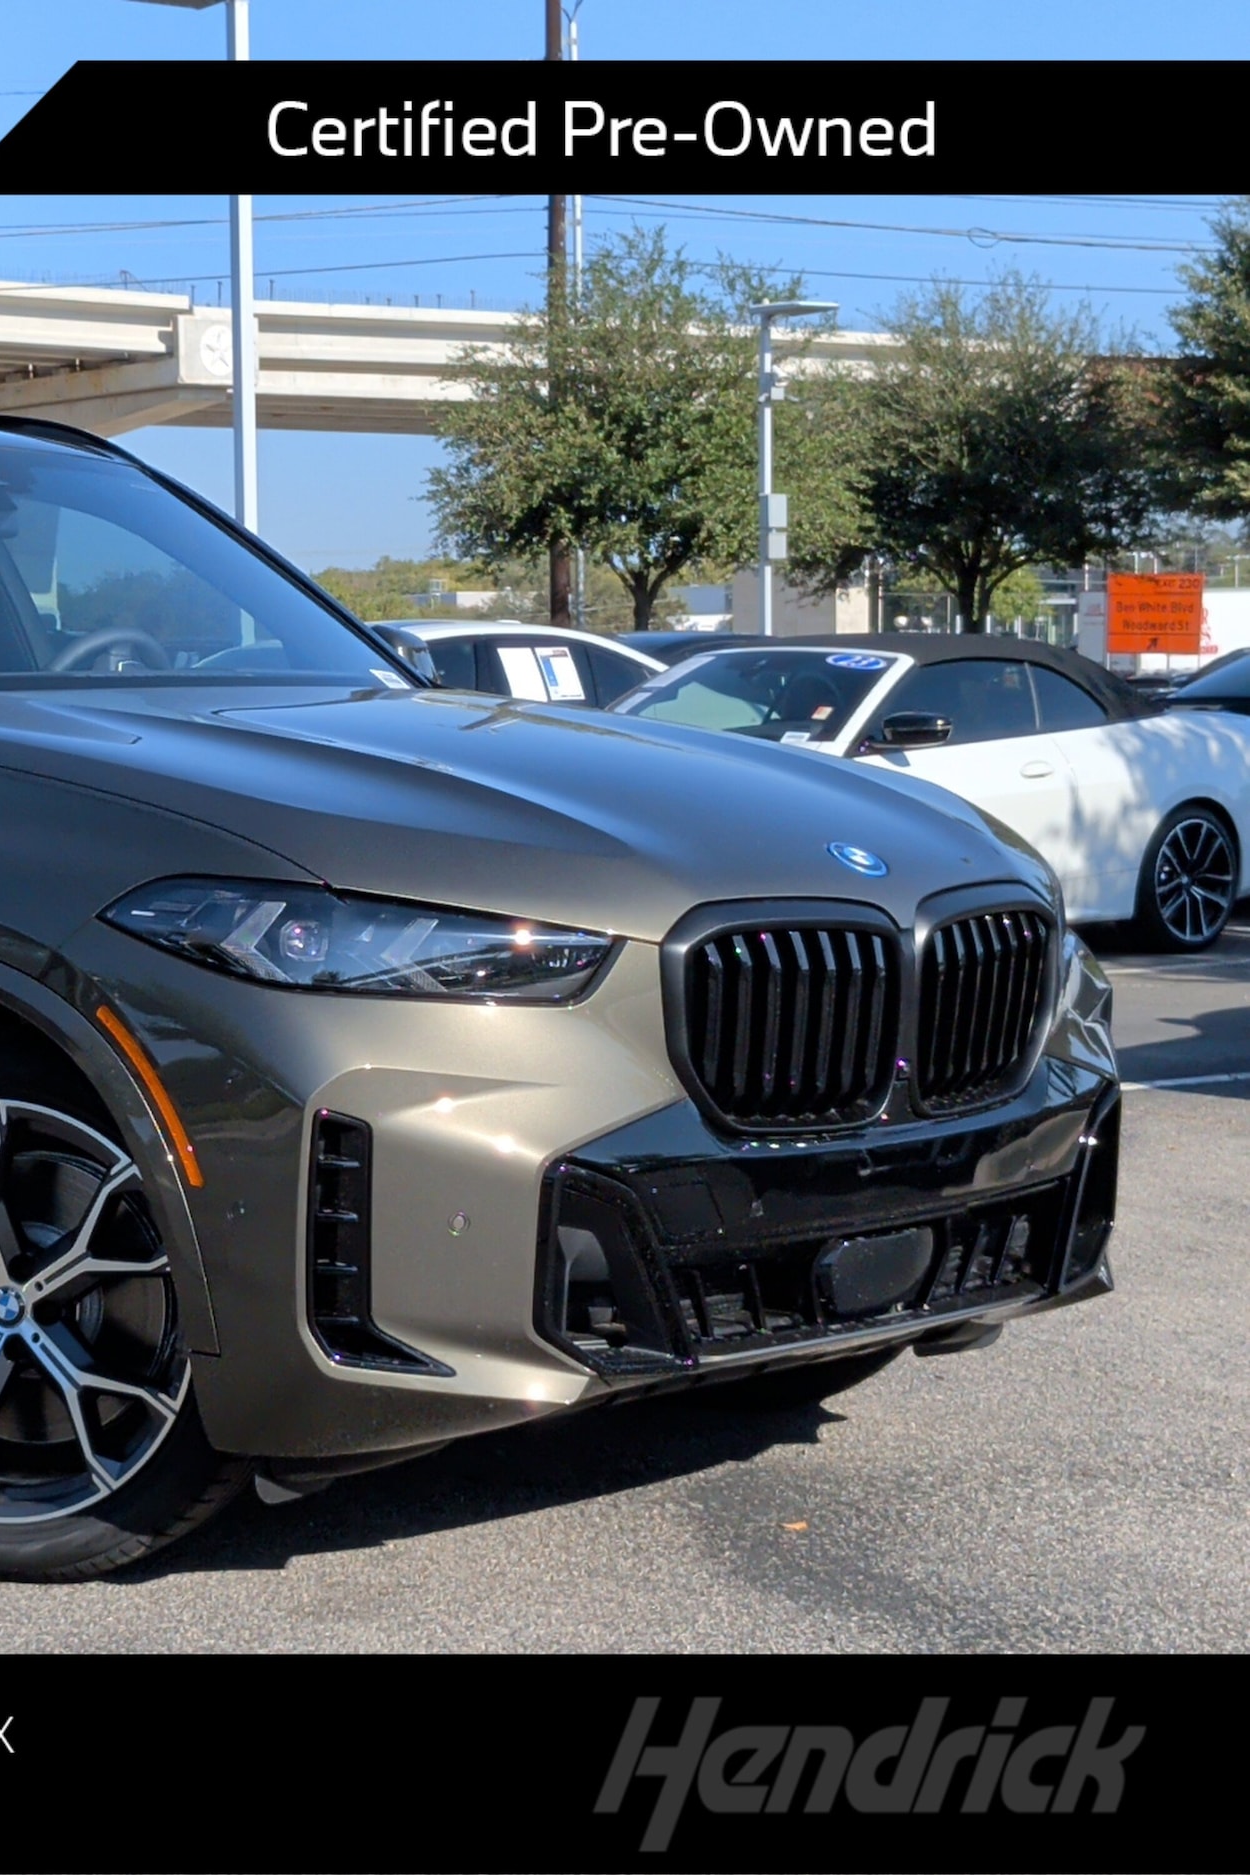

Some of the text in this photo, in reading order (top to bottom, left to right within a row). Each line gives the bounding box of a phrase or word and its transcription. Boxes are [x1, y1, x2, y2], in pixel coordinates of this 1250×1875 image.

[1179, 578, 1199, 590] 230
[1116, 601, 1194, 613] Ben White Blvd
